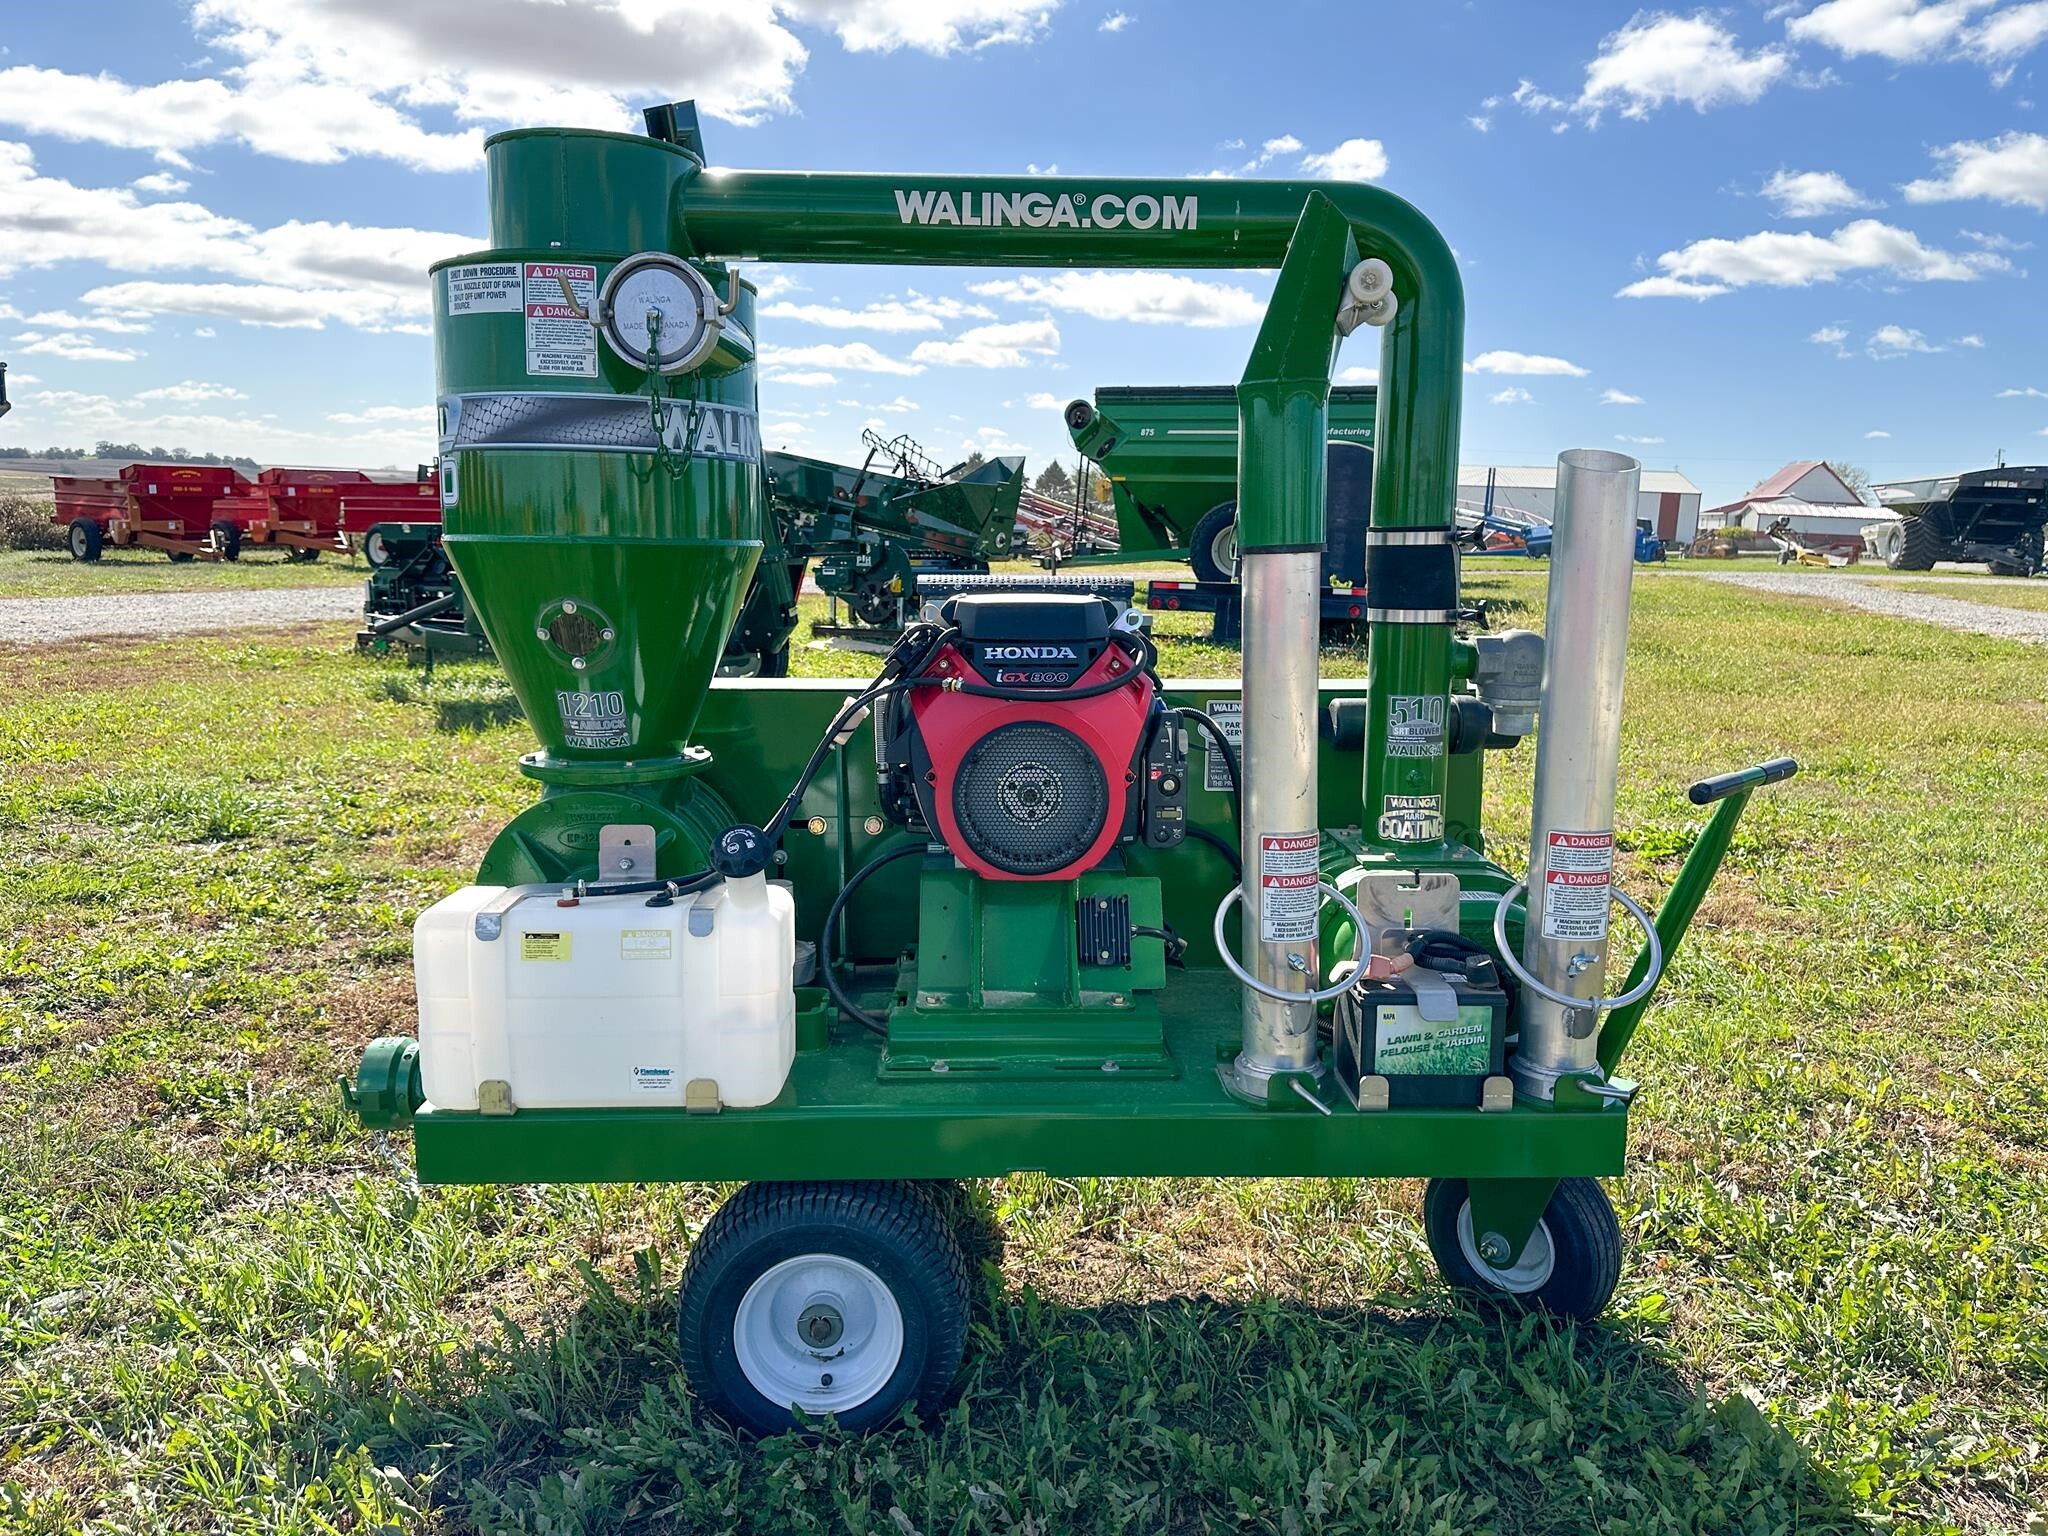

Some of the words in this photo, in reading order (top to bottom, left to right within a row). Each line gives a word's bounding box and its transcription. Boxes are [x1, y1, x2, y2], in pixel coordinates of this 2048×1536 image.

[463, 267, 478, 278] DOWN
[480, 266, 517, 276] PROCEDURE
[454, 283, 463, 291] PULL
[464, 281, 481, 290] NOZZLE
[482, 281, 492, 289] OUT
[502, 280, 520, 288] GRAIN
[465, 292, 473, 300] OFF
[486, 291, 507, 299] POWER
[639, 296, 671, 304] WALINGA
[623, 322, 643, 330] MADE
[1140, 428, 1154, 437] 875
[984, 646, 1077, 660] HONDA
[557, 691, 624, 717] 1210
[1389, 696, 1444, 726] 510
[565, 735, 630, 748] WALINGA
[1388, 743, 1443, 756] WALINGA
[1390, 798, 1437, 808] WALINGA
[1404, 812, 1425, 820] HARD
[1378, 816, 1443, 839] COATING
[1282, 837, 1317, 849] DANGER
[1571, 837, 1610, 847] DANGER
[1282, 875, 1316, 887] DANGER
[1568, 874, 1608, 884] DANGER
[1387, 1032, 1421, 1046] LAWN
[1424, 1032, 1434, 1040] &
[1436, 1023, 1483, 1039] GARDEN
[1380, 1044, 1430, 1058] PELOUSE
[1433, 1041, 1444, 1051] et
[1445, 1035, 1486, 1048] JARDIN
